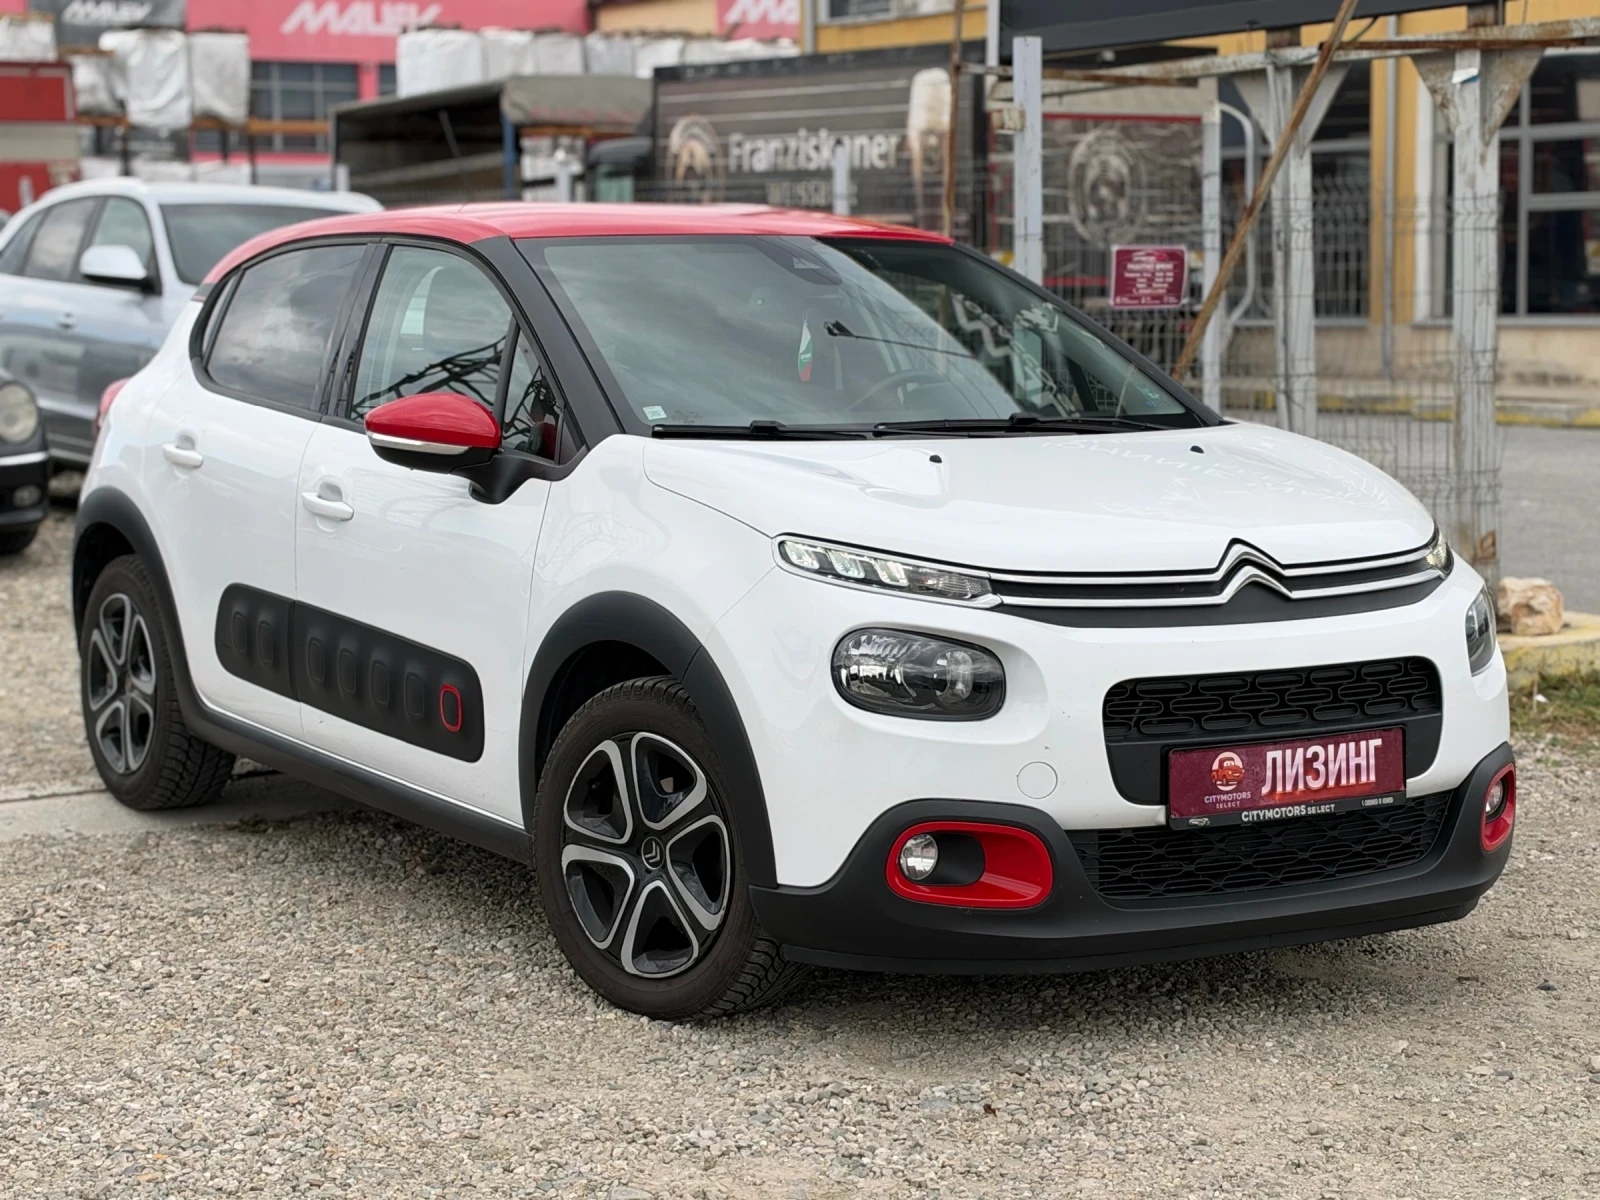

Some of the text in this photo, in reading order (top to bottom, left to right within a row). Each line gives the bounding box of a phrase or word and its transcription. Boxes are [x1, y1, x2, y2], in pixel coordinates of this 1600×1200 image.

[1260, 738, 1382, 796] ЛИЗИНГ
[1204, 791, 1252, 804] CITYMOTORS
[1215, 801, 1241, 809] SELECT
[1241, 804, 1335, 822] CITYMOTORS SELECT
